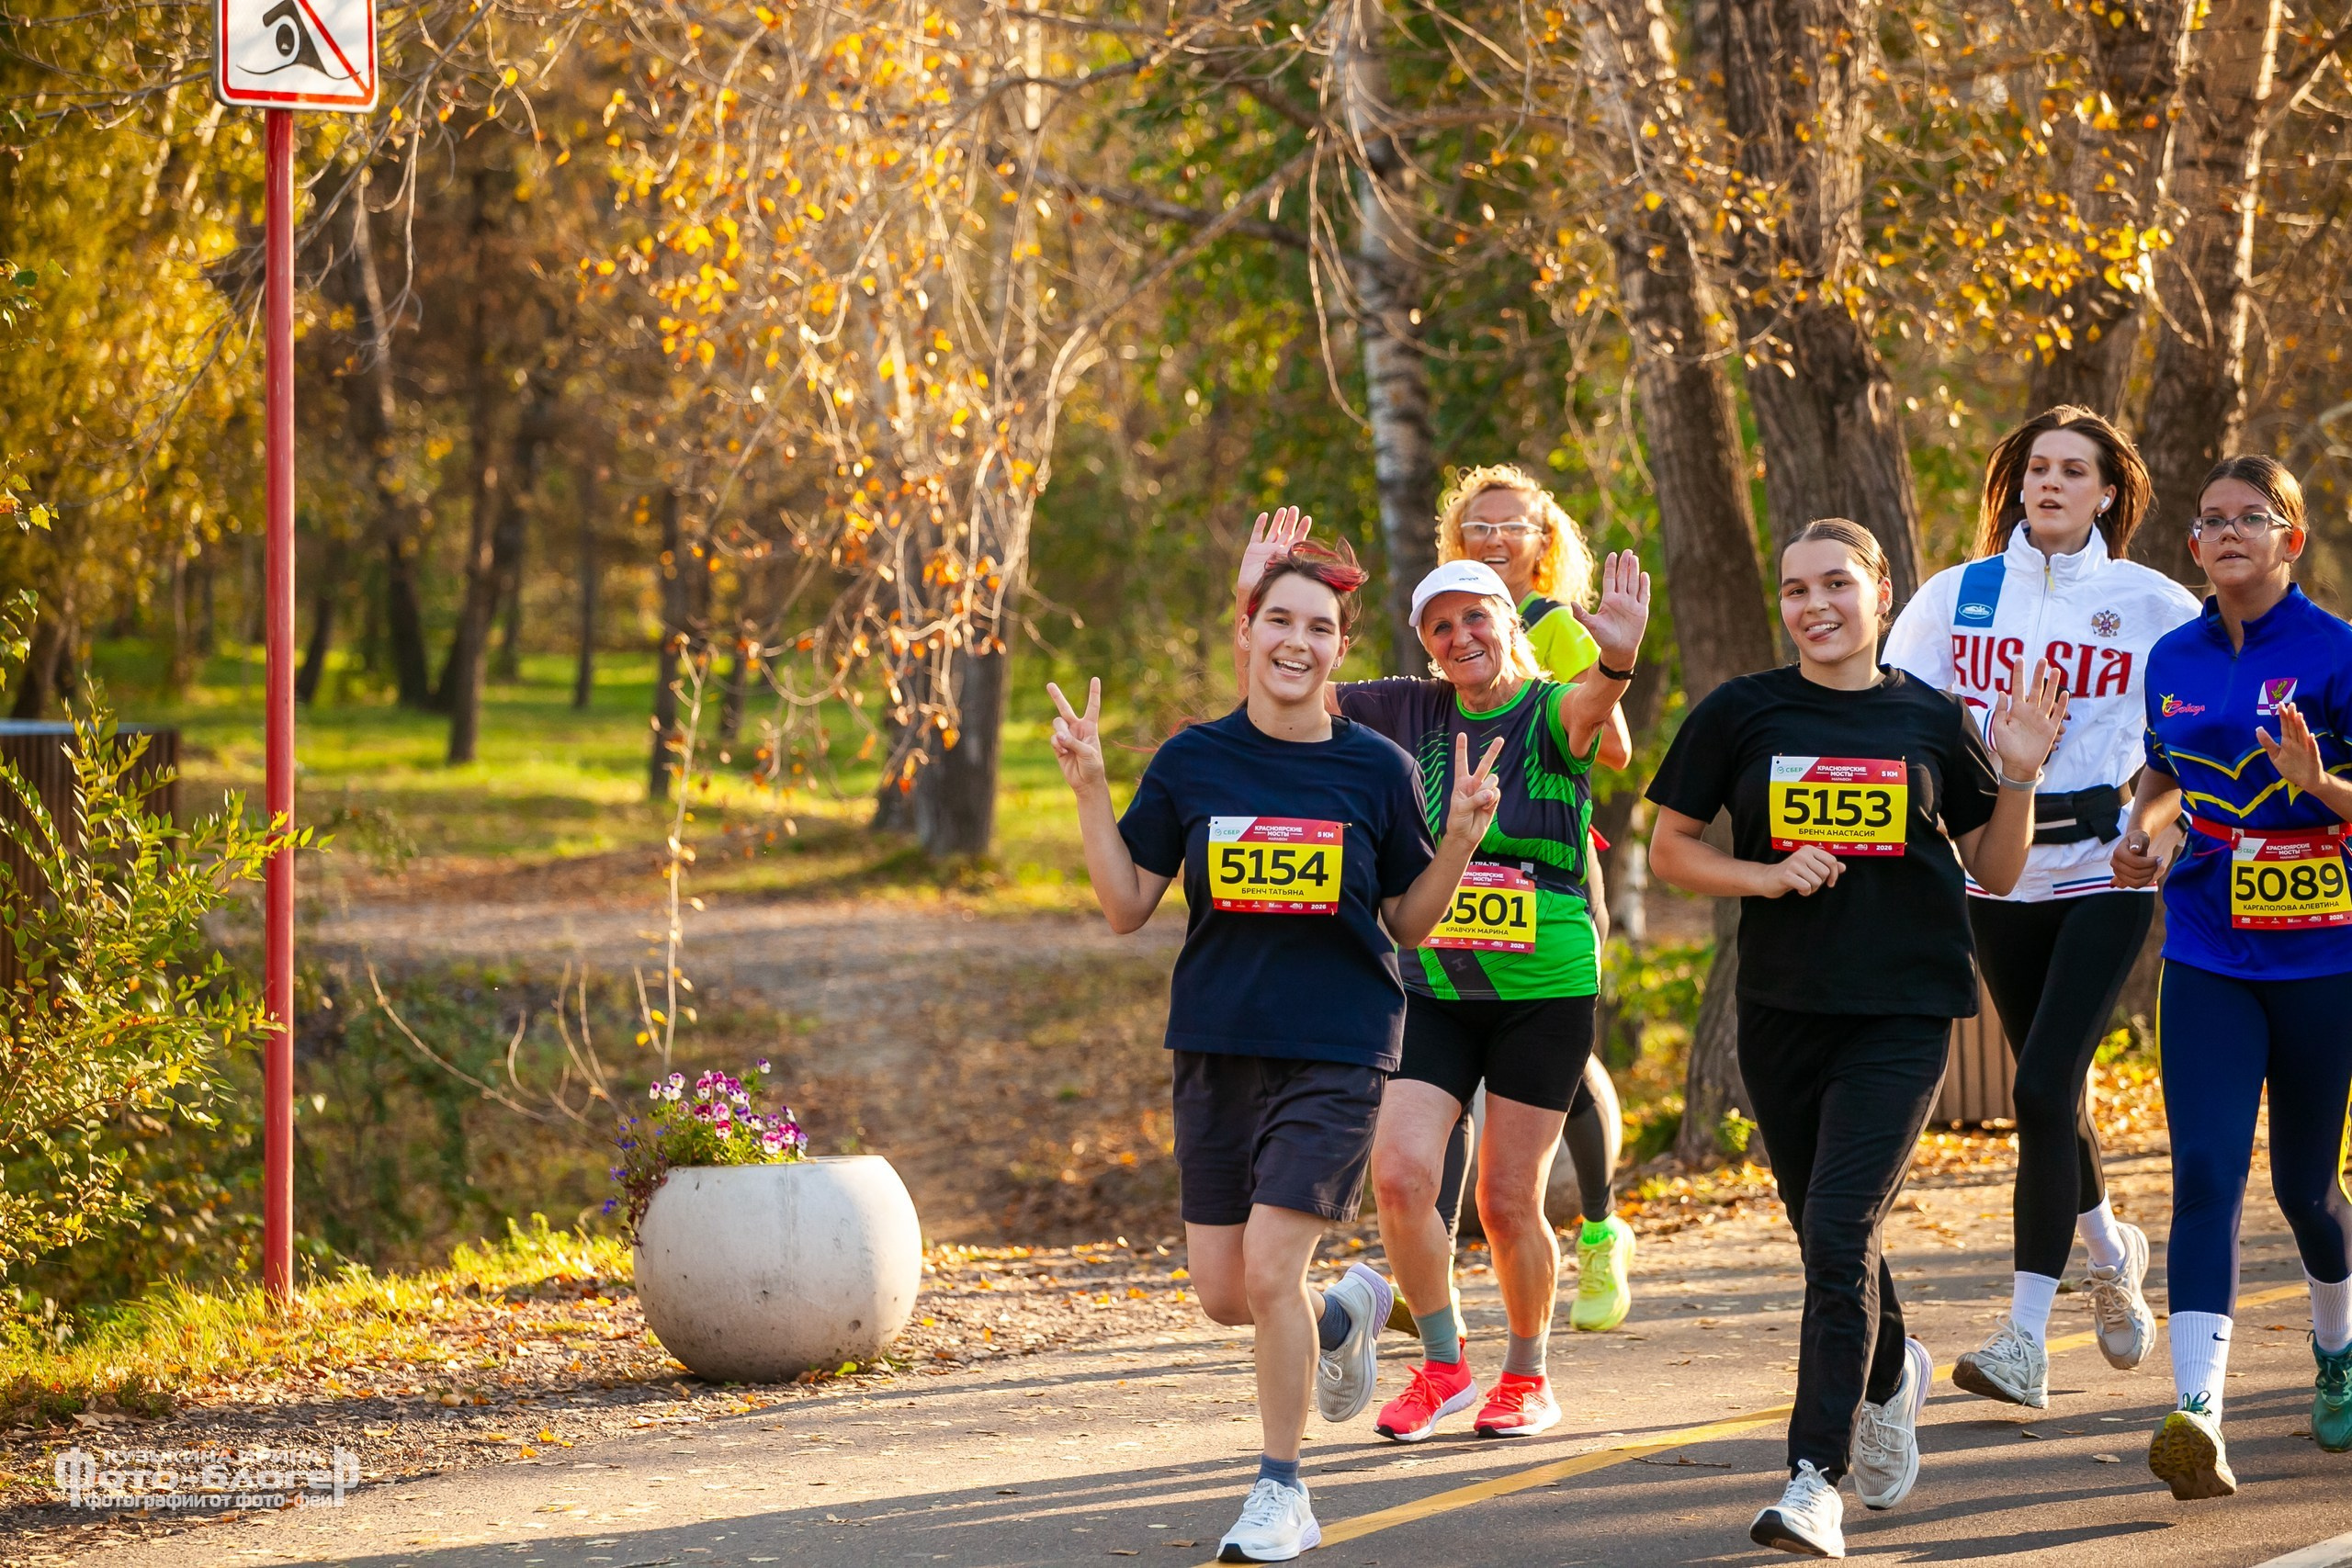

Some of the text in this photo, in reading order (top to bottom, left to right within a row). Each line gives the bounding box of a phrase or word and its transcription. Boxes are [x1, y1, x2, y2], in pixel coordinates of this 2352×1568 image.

[1951, 634, 2133, 699] RUSSIA
[1783, 787, 1893, 828] 5153
[1254, 825, 1303, 833] КРАСНОЯРСКИЕ
[1798, 828, 1875, 837] БРЕНЧ АНАСТАСИЯ
[2266, 842, 2311, 851] КРАСНОЯРСКИЕ
[1220, 848, 1329, 887] 5154
[2234, 863, 2344, 902] 5089
[1269, 888, 1305, 897] ТАТЬЯНА
[2243, 901, 2340, 911] КАРГАПОЛОВА АЛЕВТИНА
